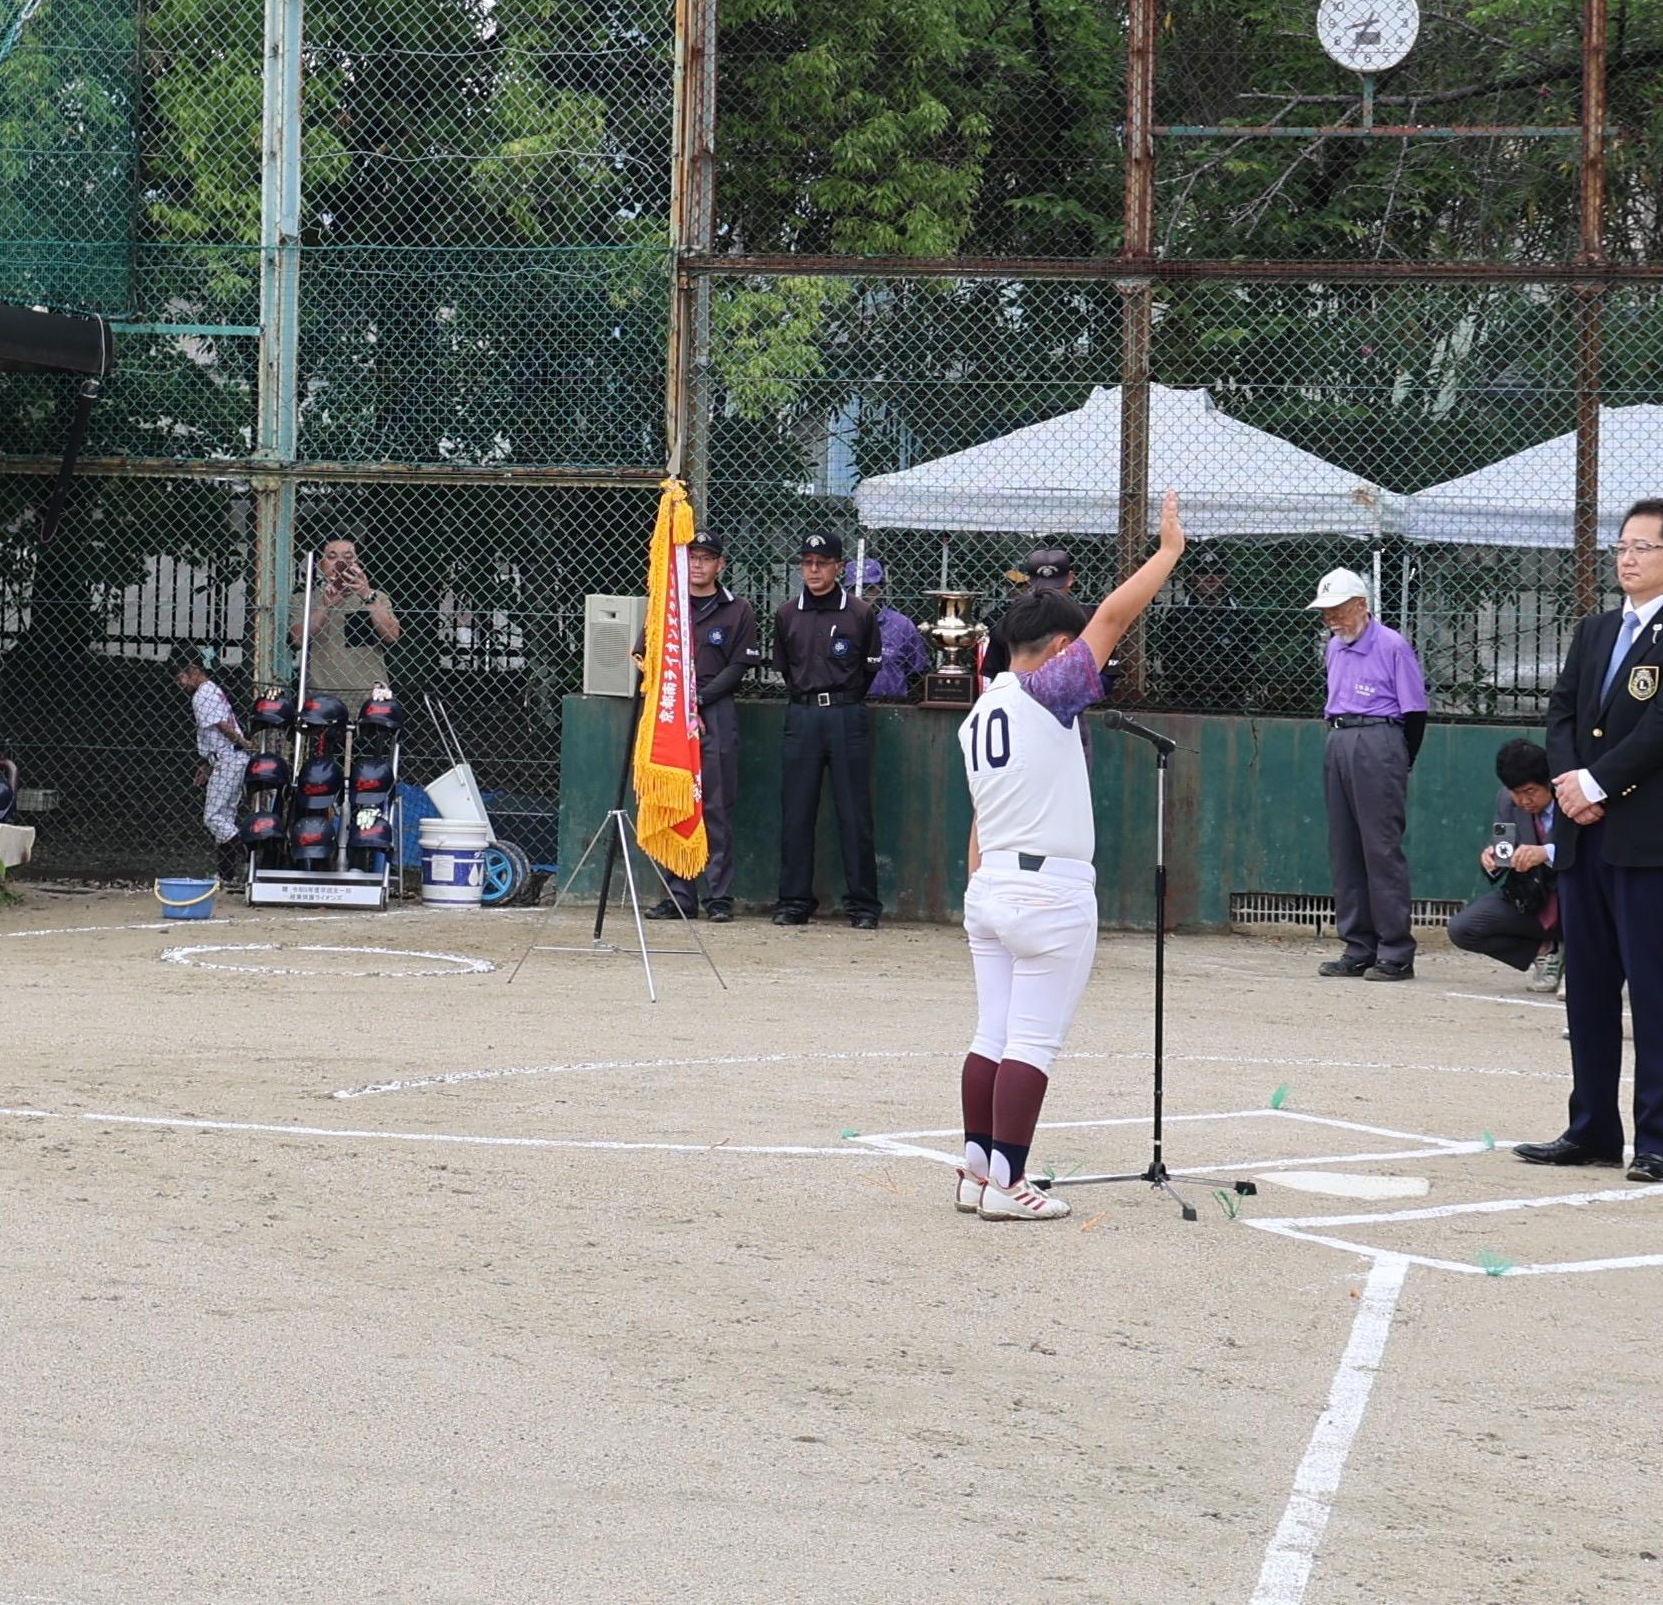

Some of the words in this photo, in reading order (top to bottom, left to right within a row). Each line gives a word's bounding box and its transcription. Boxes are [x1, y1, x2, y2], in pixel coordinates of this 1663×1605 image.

[1333, 2, 1344, 12] 10
[1397, 0, 1405, 11] 2
[1329, 19, 1336, 28] 9
[1401, 18, 1409, 28] 3
[1396, 36, 1405, 45] 4
[1364, 53, 1372, 63] 6
[969, 707, 1011, 772] 10
